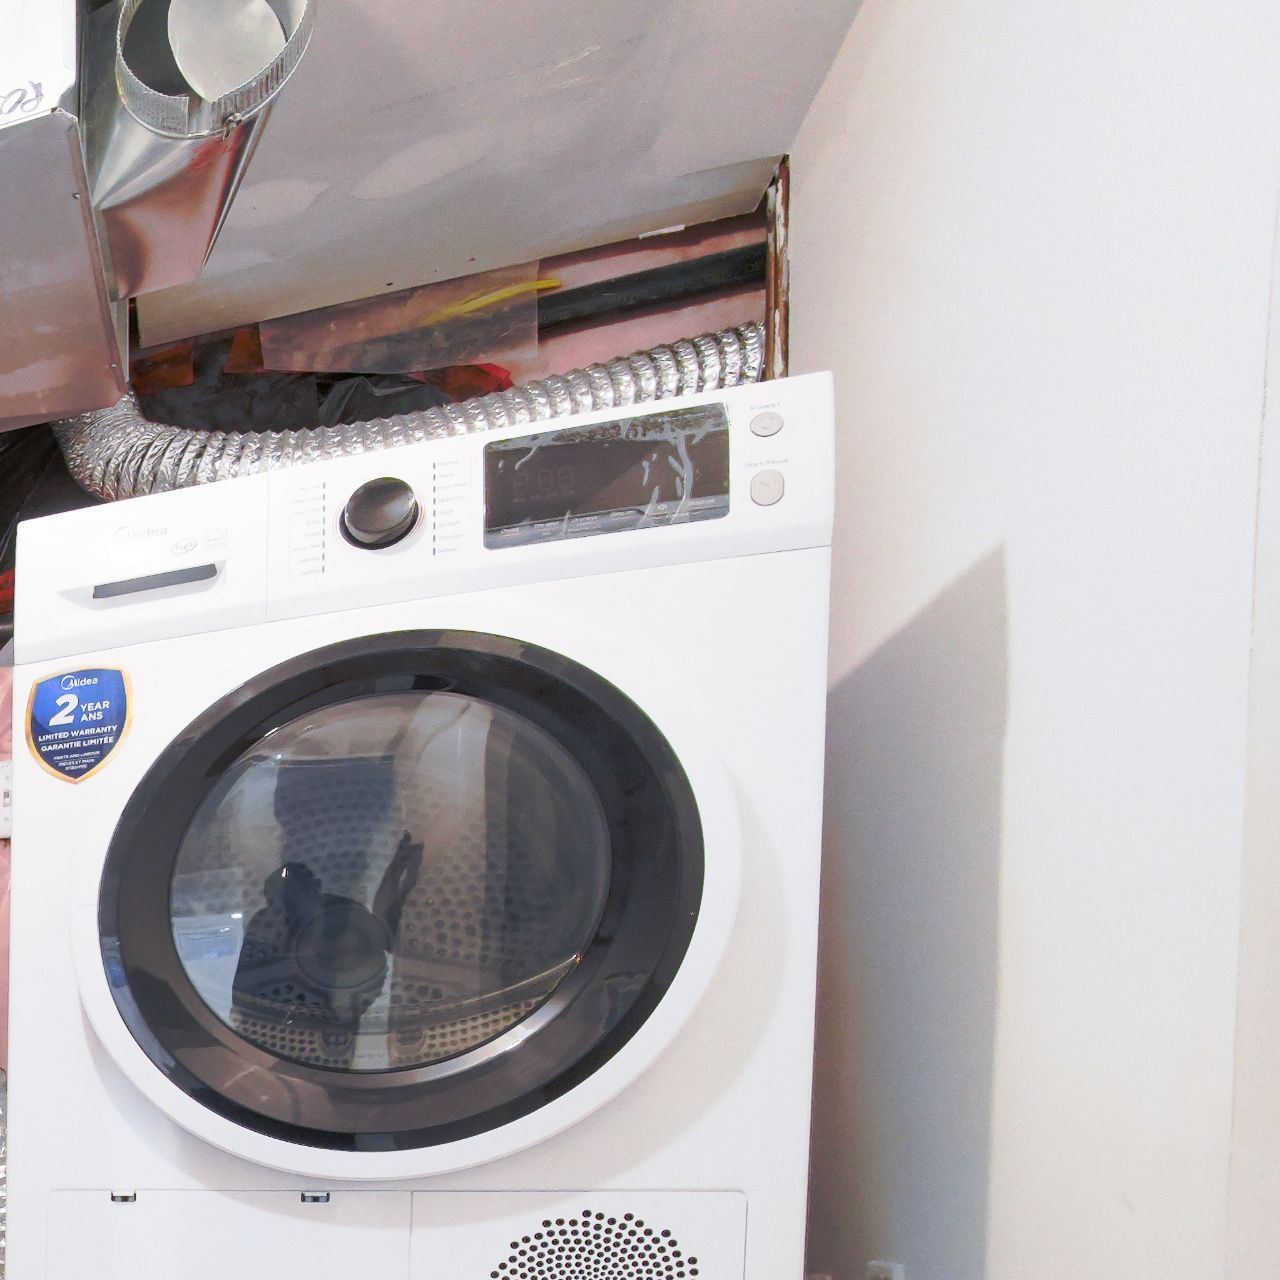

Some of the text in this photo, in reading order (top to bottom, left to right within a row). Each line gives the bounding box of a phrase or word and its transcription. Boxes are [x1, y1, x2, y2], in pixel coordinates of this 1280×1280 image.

[61, 675, 98, 690] Midea
[49, 694, 110, 726] 2 YEAR
[81, 712, 103, 722] ANS
[39, 725, 118, 741] LIMITED WARRANTY
[41, 736, 114, 752] GARANTIE LIMITÉE
